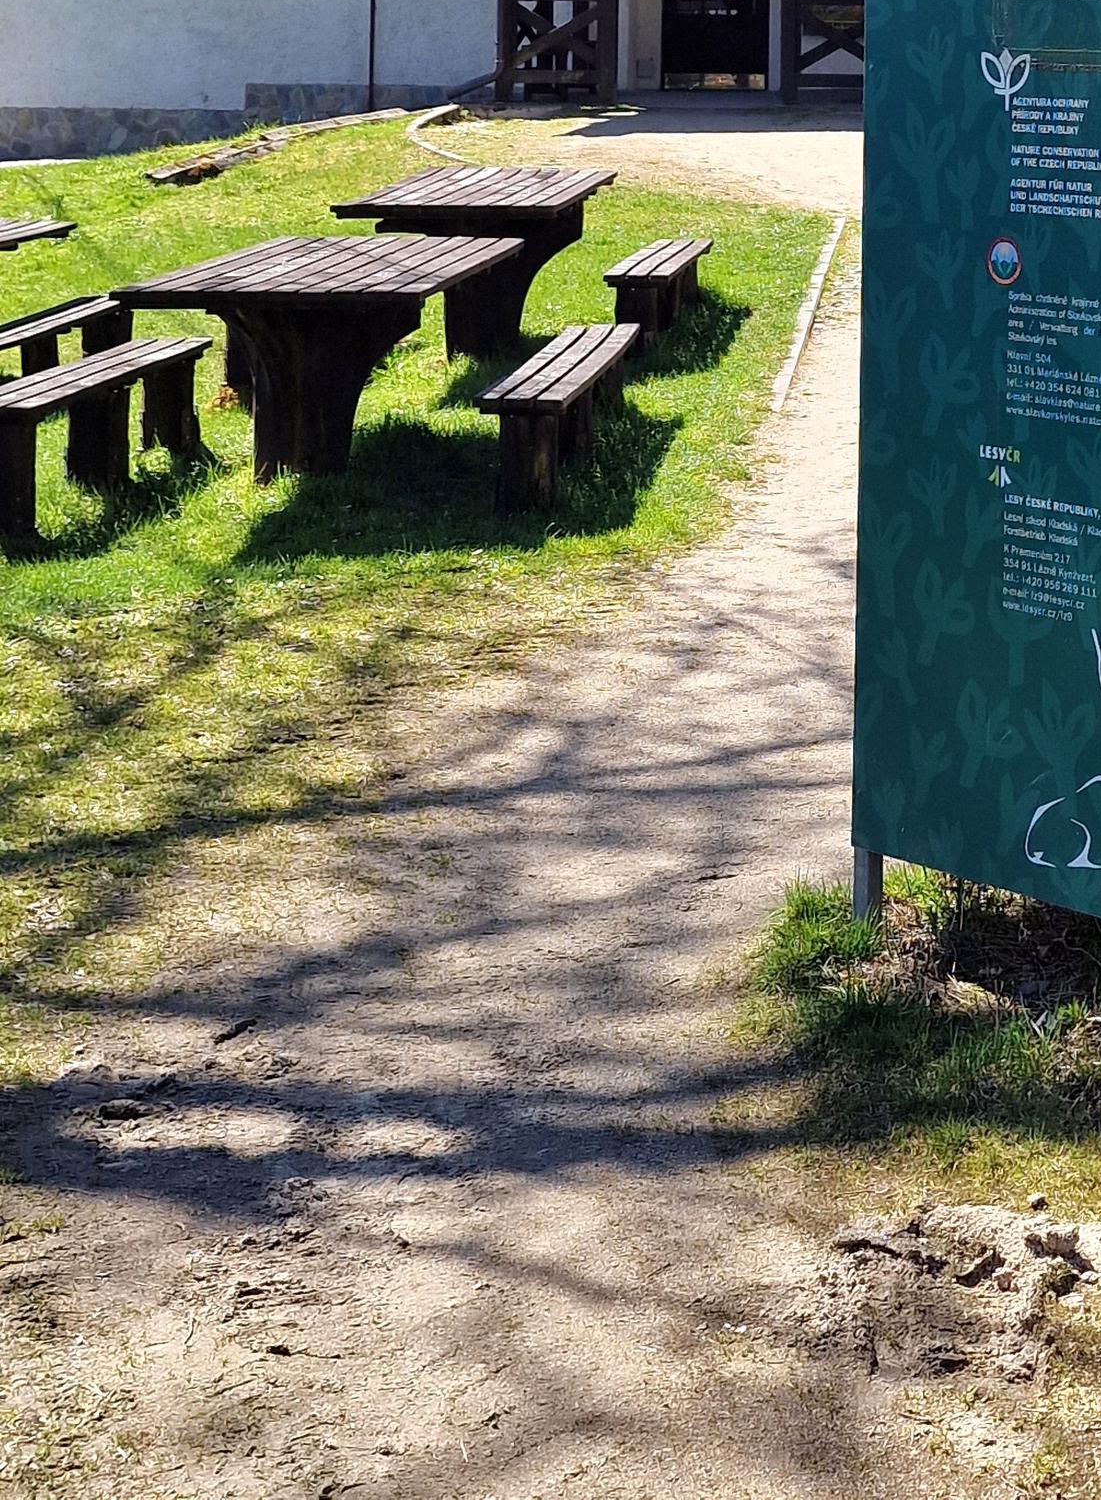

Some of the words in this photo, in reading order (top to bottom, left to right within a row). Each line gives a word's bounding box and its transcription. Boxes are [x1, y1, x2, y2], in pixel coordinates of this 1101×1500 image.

[1011, 145, 1041, 155] NATURE
[1041, 146, 1100, 158] CONSERVATION
[1010, 157, 1021, 166] OF
[1022, 157, 1038, 167] THE
[1039, 158, 1066, 169] CZECH
[1010, 178, 1047, 189] AGENTUR
[1066, 181, 1093, 192] NATUR
[1010, 190, 1027, 200] UND
[1010, 203, 1026, 213] DER
[1024, 379, 1046, 391] +420
[1047, 381, 1064, 393] 354
[1004, 493, 1024, 506] LESY
[1025, 494, 1052, 511] ČESKÉ
[1053, 500, 1101, 520] REPUBLIKY,
[1054, 552, 1071, 564] 217
[1081, 585, 1097, 598] 111
